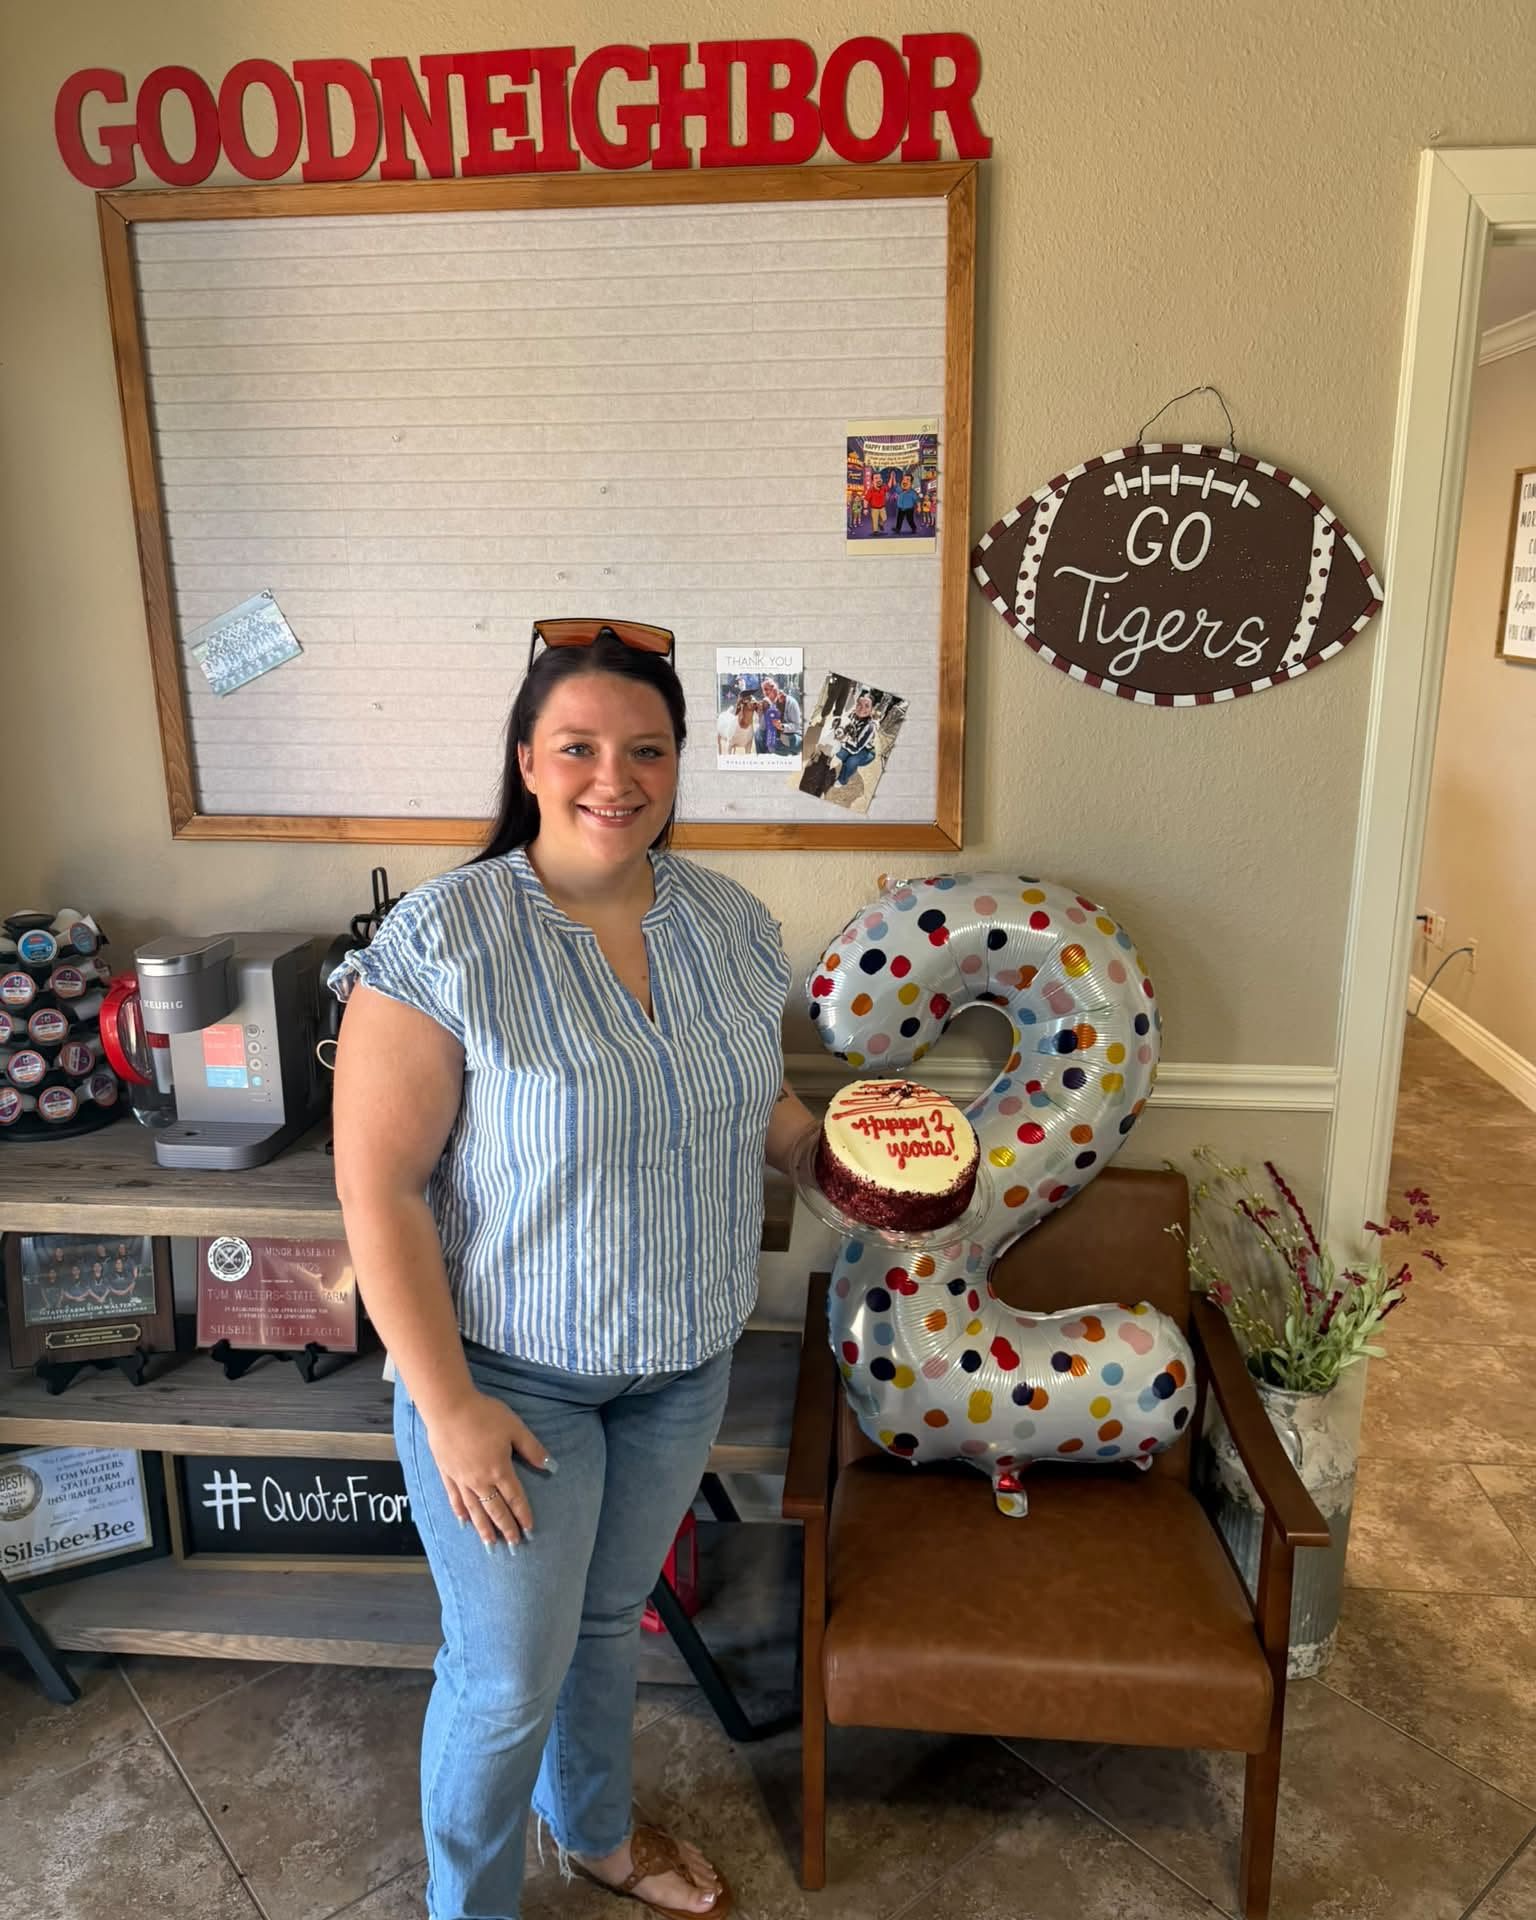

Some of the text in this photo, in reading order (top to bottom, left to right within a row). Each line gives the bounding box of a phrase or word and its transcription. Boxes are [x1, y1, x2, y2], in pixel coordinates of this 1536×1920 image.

[1126, 505, 1212, 572] GO
[1053, 565, 1271, 677] Tigers
[727, 656, 793, 667] THANK YOU
[143, 1000, 184, 1010] KEURIG
[207, 1289, 228, 1300] TOM
[55, 1459, 125, 1483] TOM WALTERS
[60, 1470, 121, 1493] STATE FARM
[104, 1477, 136, 1494] AGENT
